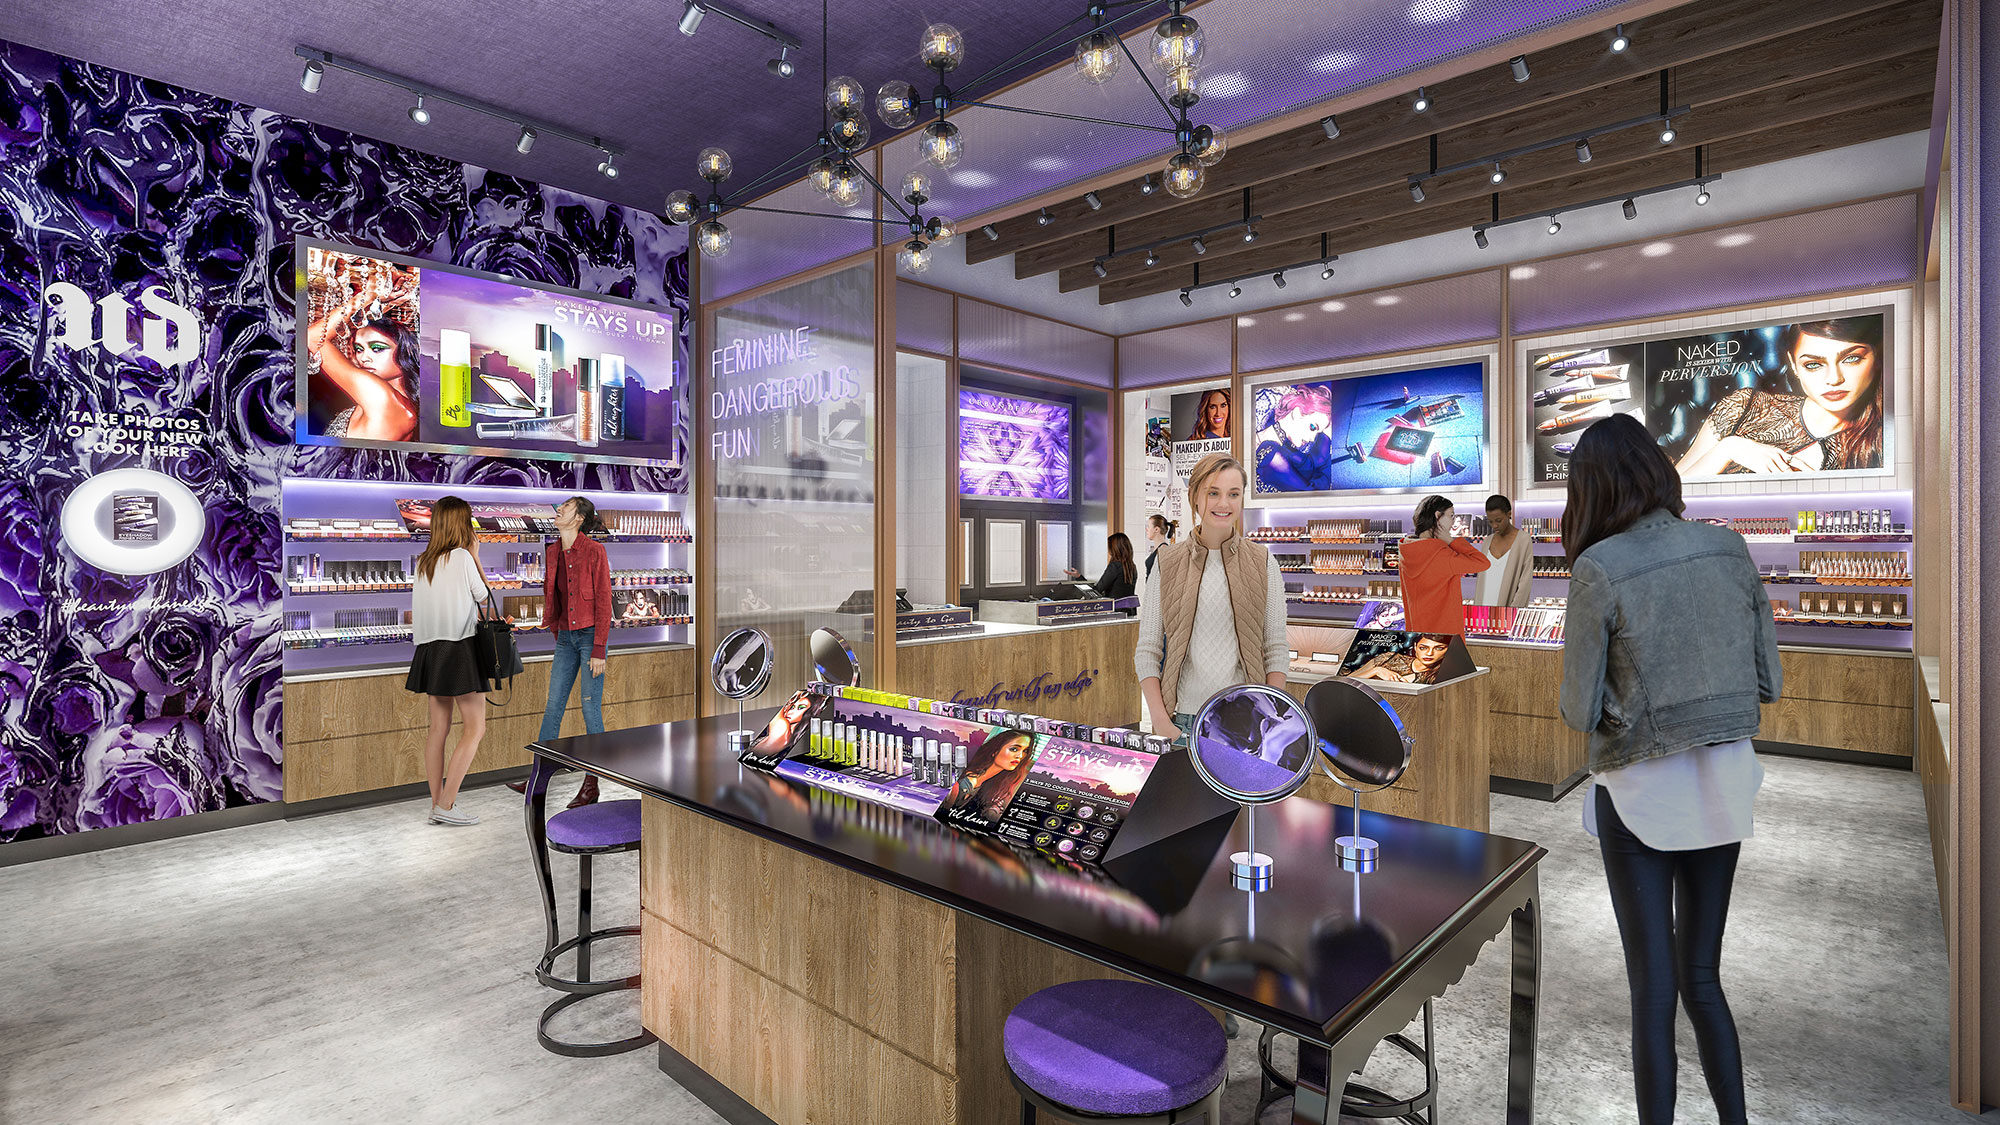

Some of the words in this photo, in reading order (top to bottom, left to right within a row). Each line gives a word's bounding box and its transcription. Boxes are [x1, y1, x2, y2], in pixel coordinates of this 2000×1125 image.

[554, 299, 597, 311] MAKEUP
[604, 308, 628, 318] THAT
[554, 306, 628, 334] STAYS
[635, 320, 666, 340] UP
[712, 325, 810, 379] FEMININE
[1678, 340, 1741, 361] NAKED
[1659, 359, 1762, 382] PERVERSION
[712, 365, 851, 420] DANGEROUS
[70, 410, 118, 425] TAKE
[124, 414, 200, 430] PHOTOS
[160, 431, 204, 445] NEW
[712, 426, 751, 461] FUN
[1176, 442, 1202, 454] MAKEUP
[1203, 442, 1210, 451] IS
[1211, 440, 1231, 451] ABOU
[144, 444, 190, 458] HERE
[1055, 605, 1080, 614] Beauty
[1094, 603, 1104, 611] Go
[896, 618, 921, 627] auty
[925, 616, 936, 624] to
[940, 614, 955, 623] Go
[1044, 748, 1109, 771] STAYS
[1051, 744, 1086, 754] MAKEUP
[1090, 751, 1113, 760] THAT
[803, 769, 868, 791] STAYS
[871, 785, 905, 803] UP
[1094, 793, 1131, 806] COMPLEXION
